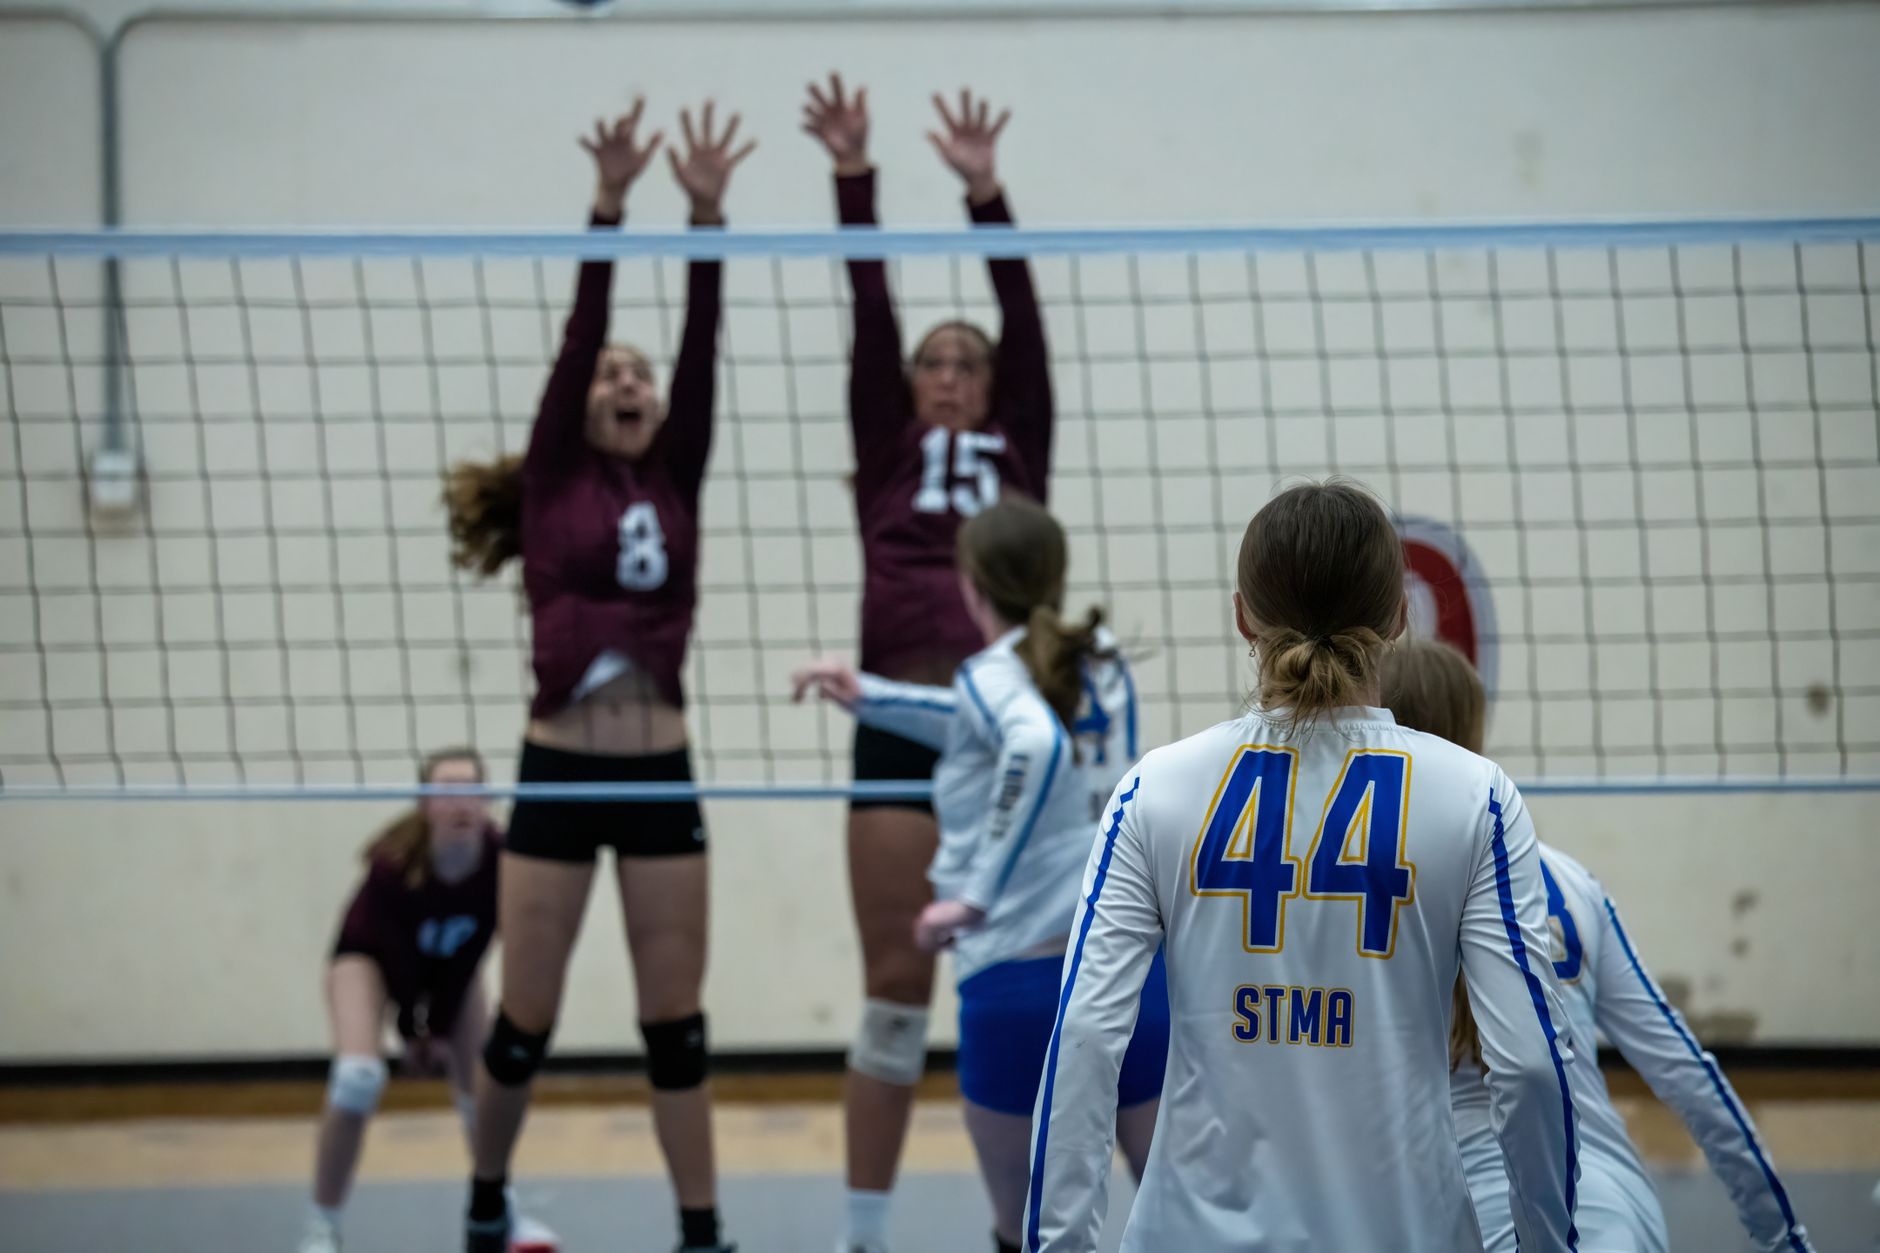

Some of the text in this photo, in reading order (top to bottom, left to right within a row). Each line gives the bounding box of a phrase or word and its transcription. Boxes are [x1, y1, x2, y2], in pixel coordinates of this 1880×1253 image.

[911, 425, 1006, 517] 15
[617, 501, 669, 592] 8
[1190, 744, 1416, 960] 44
[1233, 985, 1354, 1047] STMA
